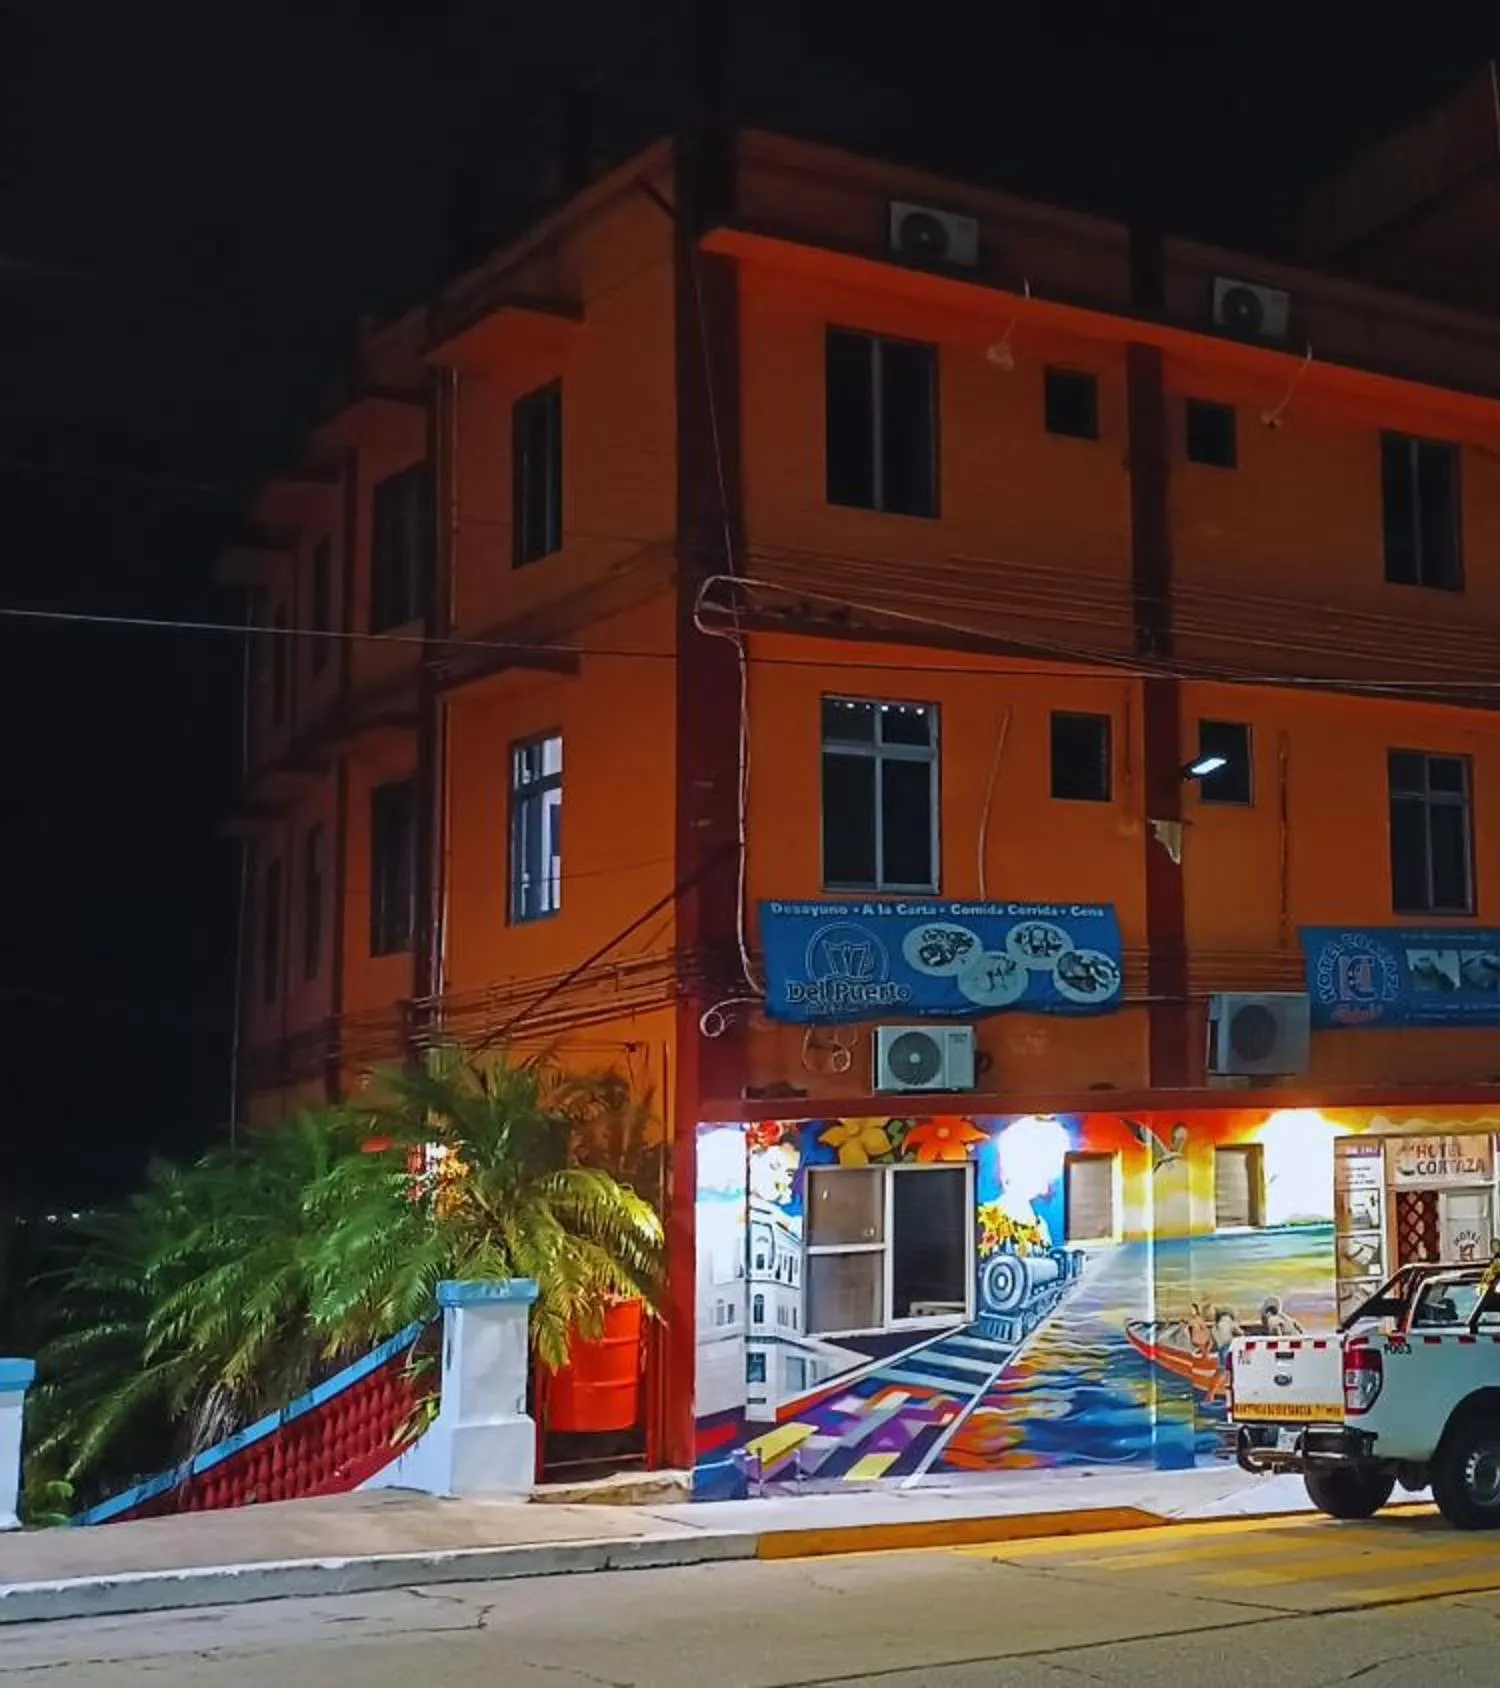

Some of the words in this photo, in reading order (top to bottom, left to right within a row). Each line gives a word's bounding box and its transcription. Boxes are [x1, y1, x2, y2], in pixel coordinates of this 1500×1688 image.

[770, 903, 849, 917] Desayuno
[862, 903, 875, 915] A
[878, 903, 893, 915] la
[896, 903, 937, 916] Carta
[950, 903, 1004, 917] Comida
[1007, 904, 1058, 917] Corrida
[1070, 905, 1105, 918] Cena
[785, 976, 829, 1003] Del
[832, 979, 914, 1006] Puerto
[1416, 1141, 1463, 1158] HOTEL
[1416, 1158, 1485, 1175] CORTAZA
